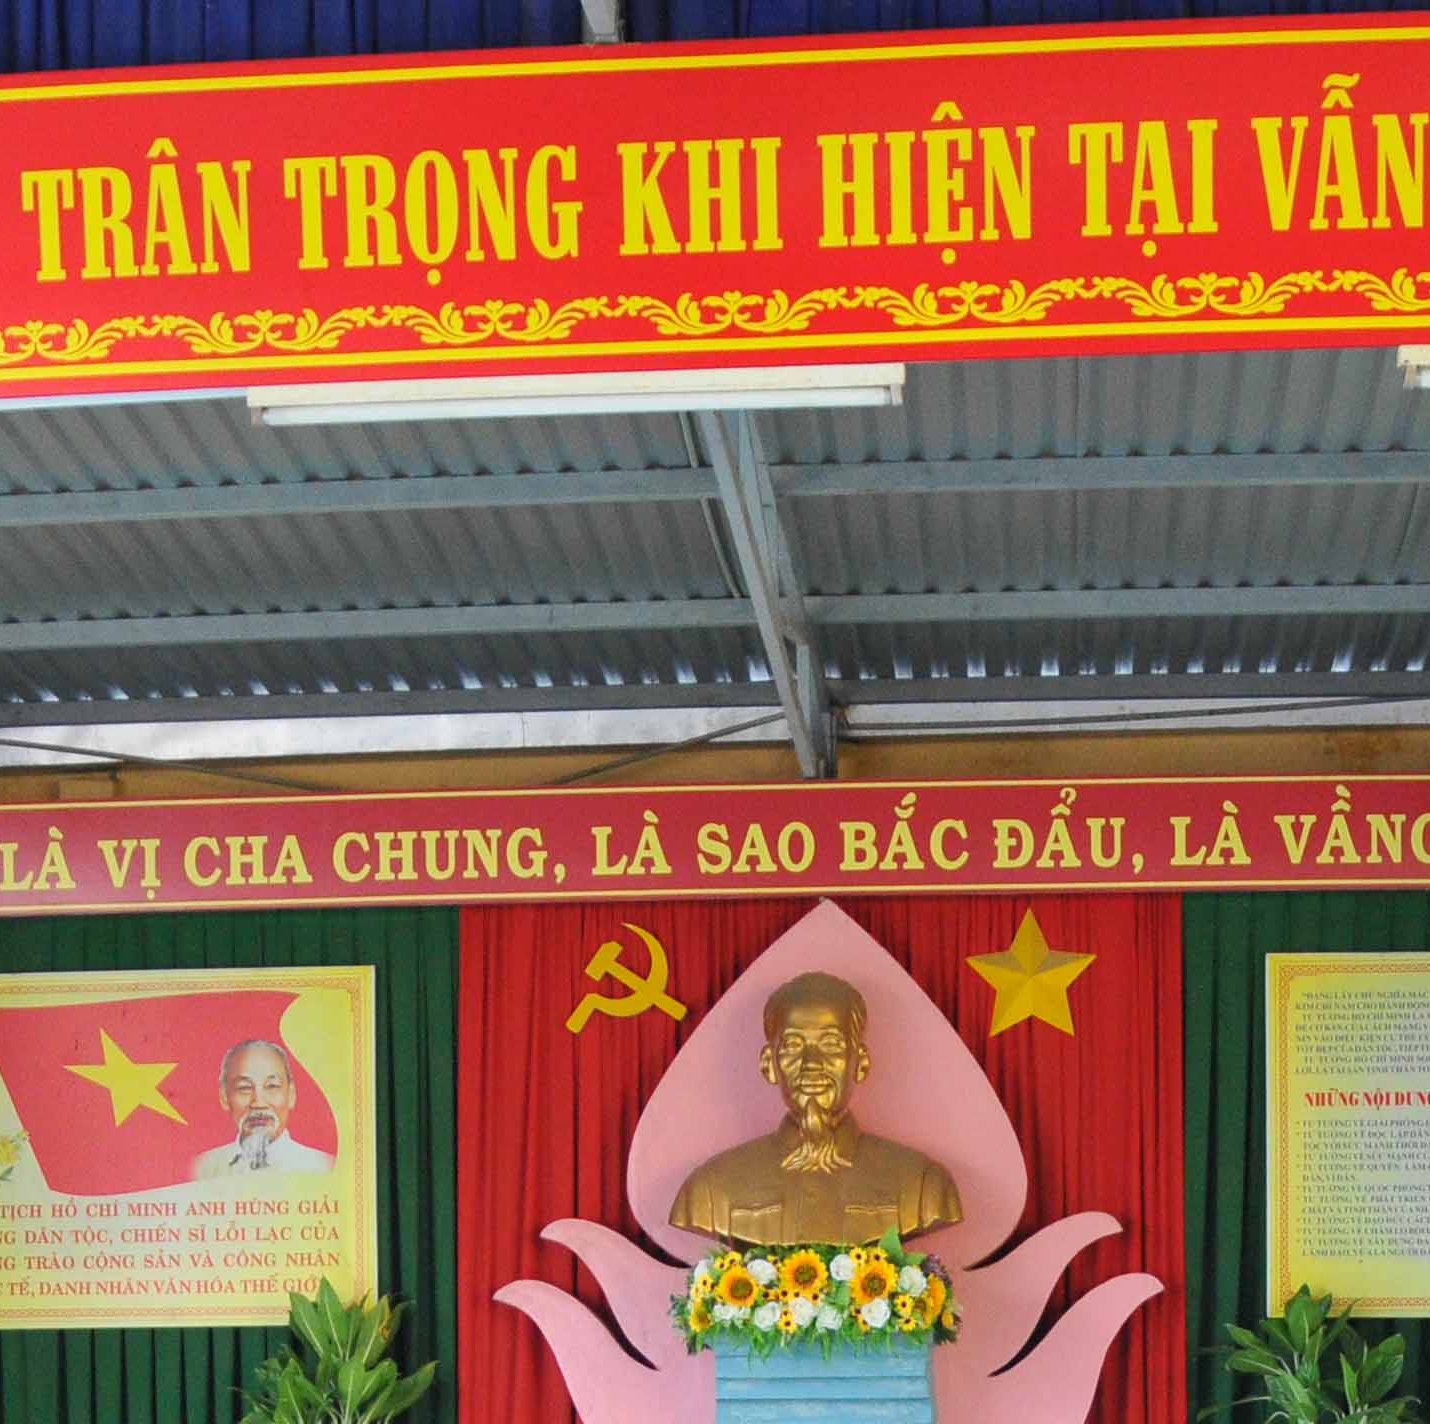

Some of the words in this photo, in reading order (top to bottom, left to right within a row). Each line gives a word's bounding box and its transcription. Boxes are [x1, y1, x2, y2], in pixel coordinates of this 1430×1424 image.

[21, 138, 251, 282] TRÂN
[284, 145, 583, 285] TRỌNG
[618, 137, 783, 255] KHI
[817, 102, 1035, 264] HIỆN
[1069, 119, 1218, 256] TẠI
[1251, 74, 1429, 230] VẪN
[98, 839, 161, 900] VỊ
[184, 835, 313, 887] CHA
[333, 828, 565, 883] CHUNG,
[592, 810, 672, 875] LÀ
[698, 822, 815, 874] SAO
[840, 792, 969, 871] BẮC
[993, 788, 1143, 874] ĐẨU,
[1170, 800, 1251, 865] LÀ
[51, 1198, 77, 1218] HỒ
[86, 1202, 119, 1217] CHÍ
[128, 1202, 177, 1217] MINH
[186, 1201, 225, 1216] ANH
[235, 1199, 289, 1216] HÙNG
[298, 1195, 339, 1215] GIẢI
[25, 1227, 63, 1244] DÂN
[70, 1226, 113, 1245] TỘC,
[121, 1223, 180, 1242] CHIẾN
[188, 1225, 206, 1242] SĨ
[215, 1220, 246, 1241] LỖI
[255, 1227, 291, 1244] LẠC
[300, 1221, 339, 1240] CỦA
[24, 1252, 74, 1269] TRÀO
[83, 1251, 134, 1272] CỘNG
[144, 1249, 180, 1267] SẢN
[189, 1250, 213, 1267] VÀ
[223, 1250, 275, 1267] CÔNG
[286, 1250, 339, 1266] NHÂN
[9, 1276, 35, 1298] TẾ,
[39, 1281, 90, 1296] DANH
[96, 1279, 148, 1294] NHÂN
[154, 1277, 191, 1294] VĂN
[197, 1276, 235, 1293] HÓA
[241, 1274, 278, 1293] THẾ
